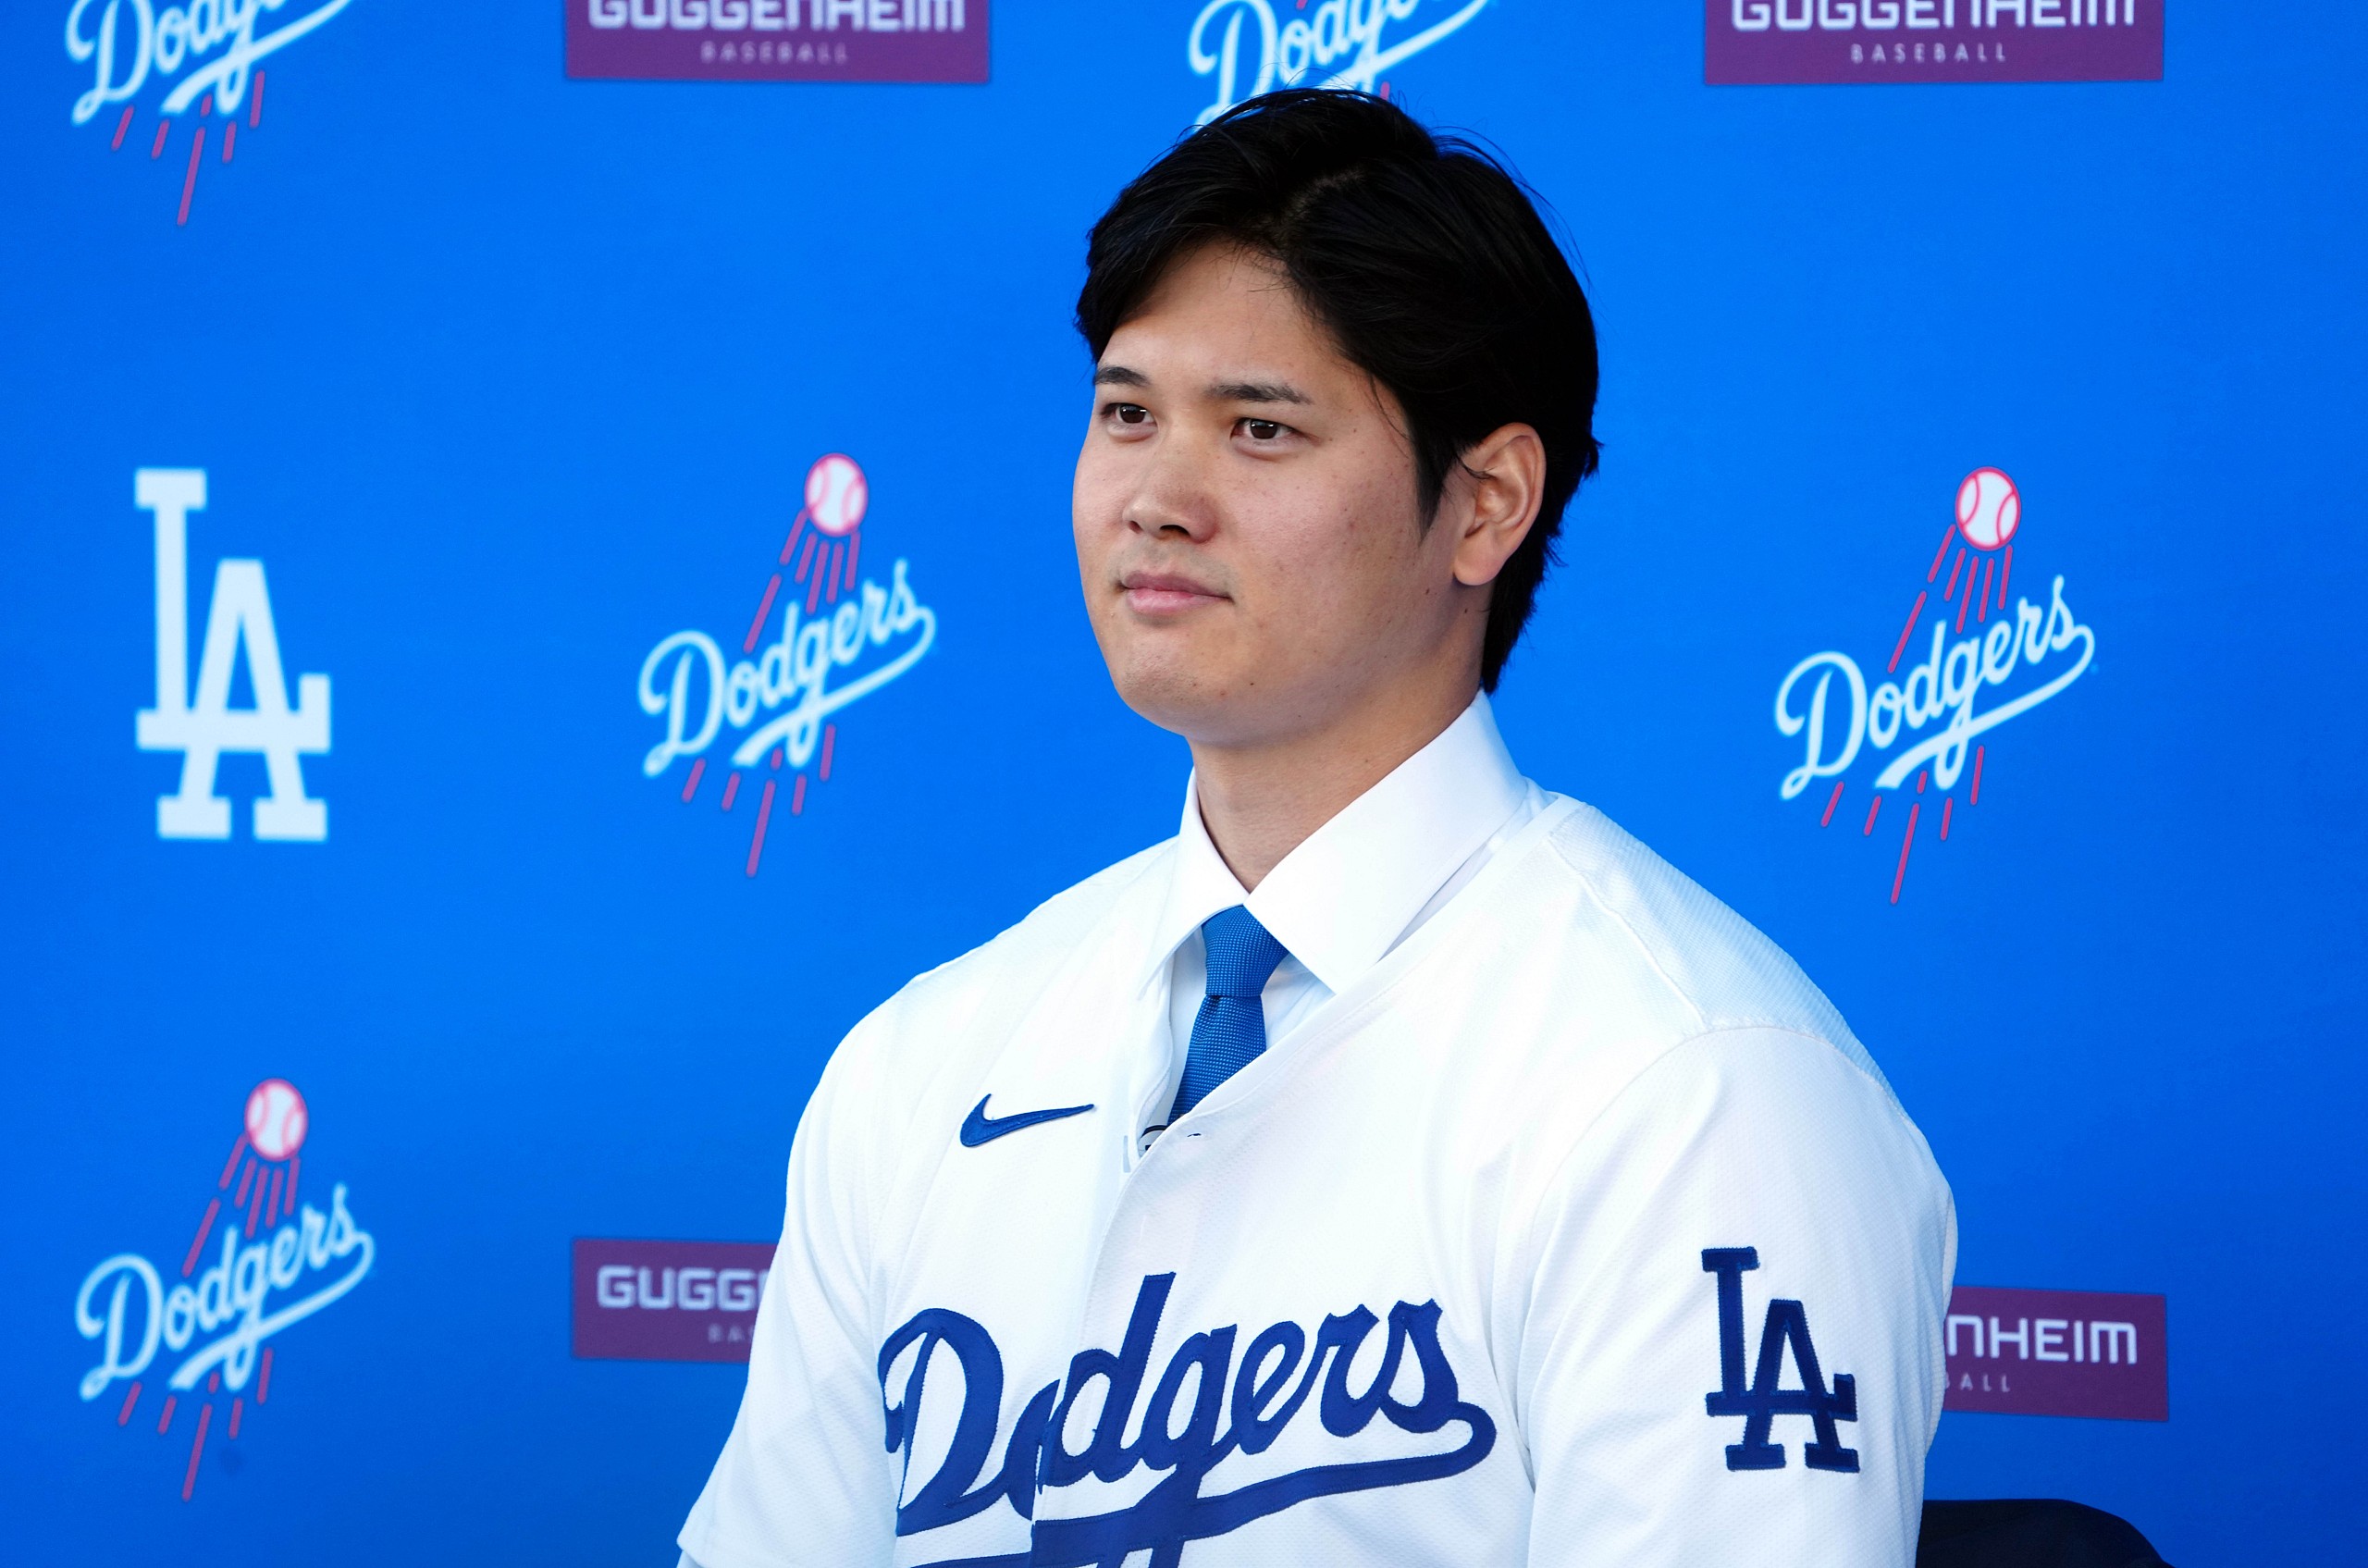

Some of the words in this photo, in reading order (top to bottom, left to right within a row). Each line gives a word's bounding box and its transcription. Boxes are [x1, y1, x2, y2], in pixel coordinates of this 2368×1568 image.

[66, 0, 352, 126] Dodg
[700, 41, 848, 65] BASEBALL
[1188, 0, 1491, 130] Dodg
[1851, 42, 2006, 63] BASEBALL
[134, 467, 332, 843] LA
[638, 558, 937, 777] Dodgers
[1775, 574, 2095, 800] Dodgers
[75, 1181, 375, 1401] Dodgers
[597, 1264, 770, 1311] GUGG
[1701, 1245, 1860, 1473] LA
